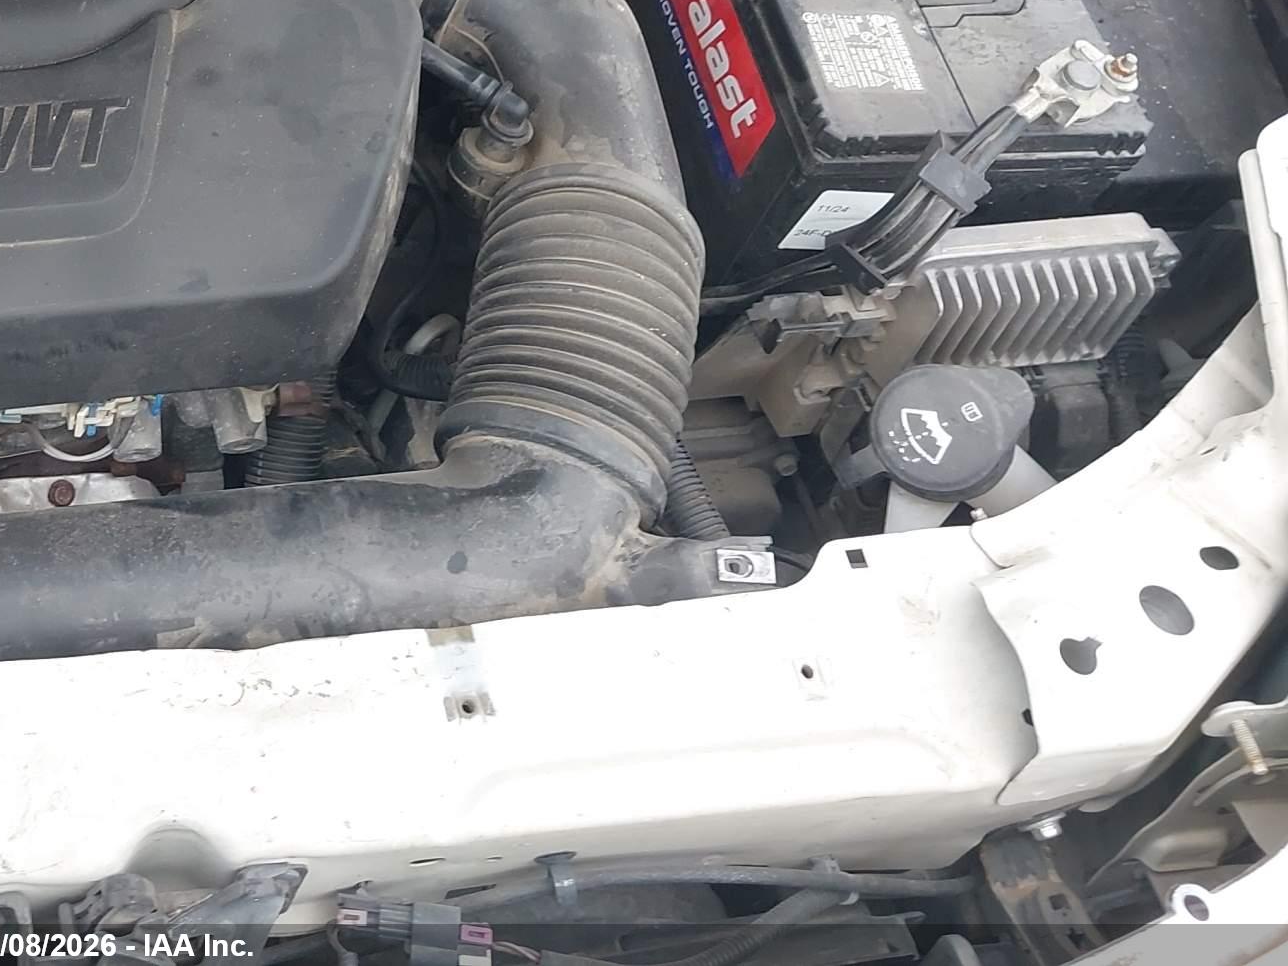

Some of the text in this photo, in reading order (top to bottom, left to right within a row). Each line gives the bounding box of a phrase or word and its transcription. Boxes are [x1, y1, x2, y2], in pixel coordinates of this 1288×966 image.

[684, 57, 715, 129] TOUGH
[816, 204, 851, 213] 11/24
[793, 228, 832, 237] 24F-D
